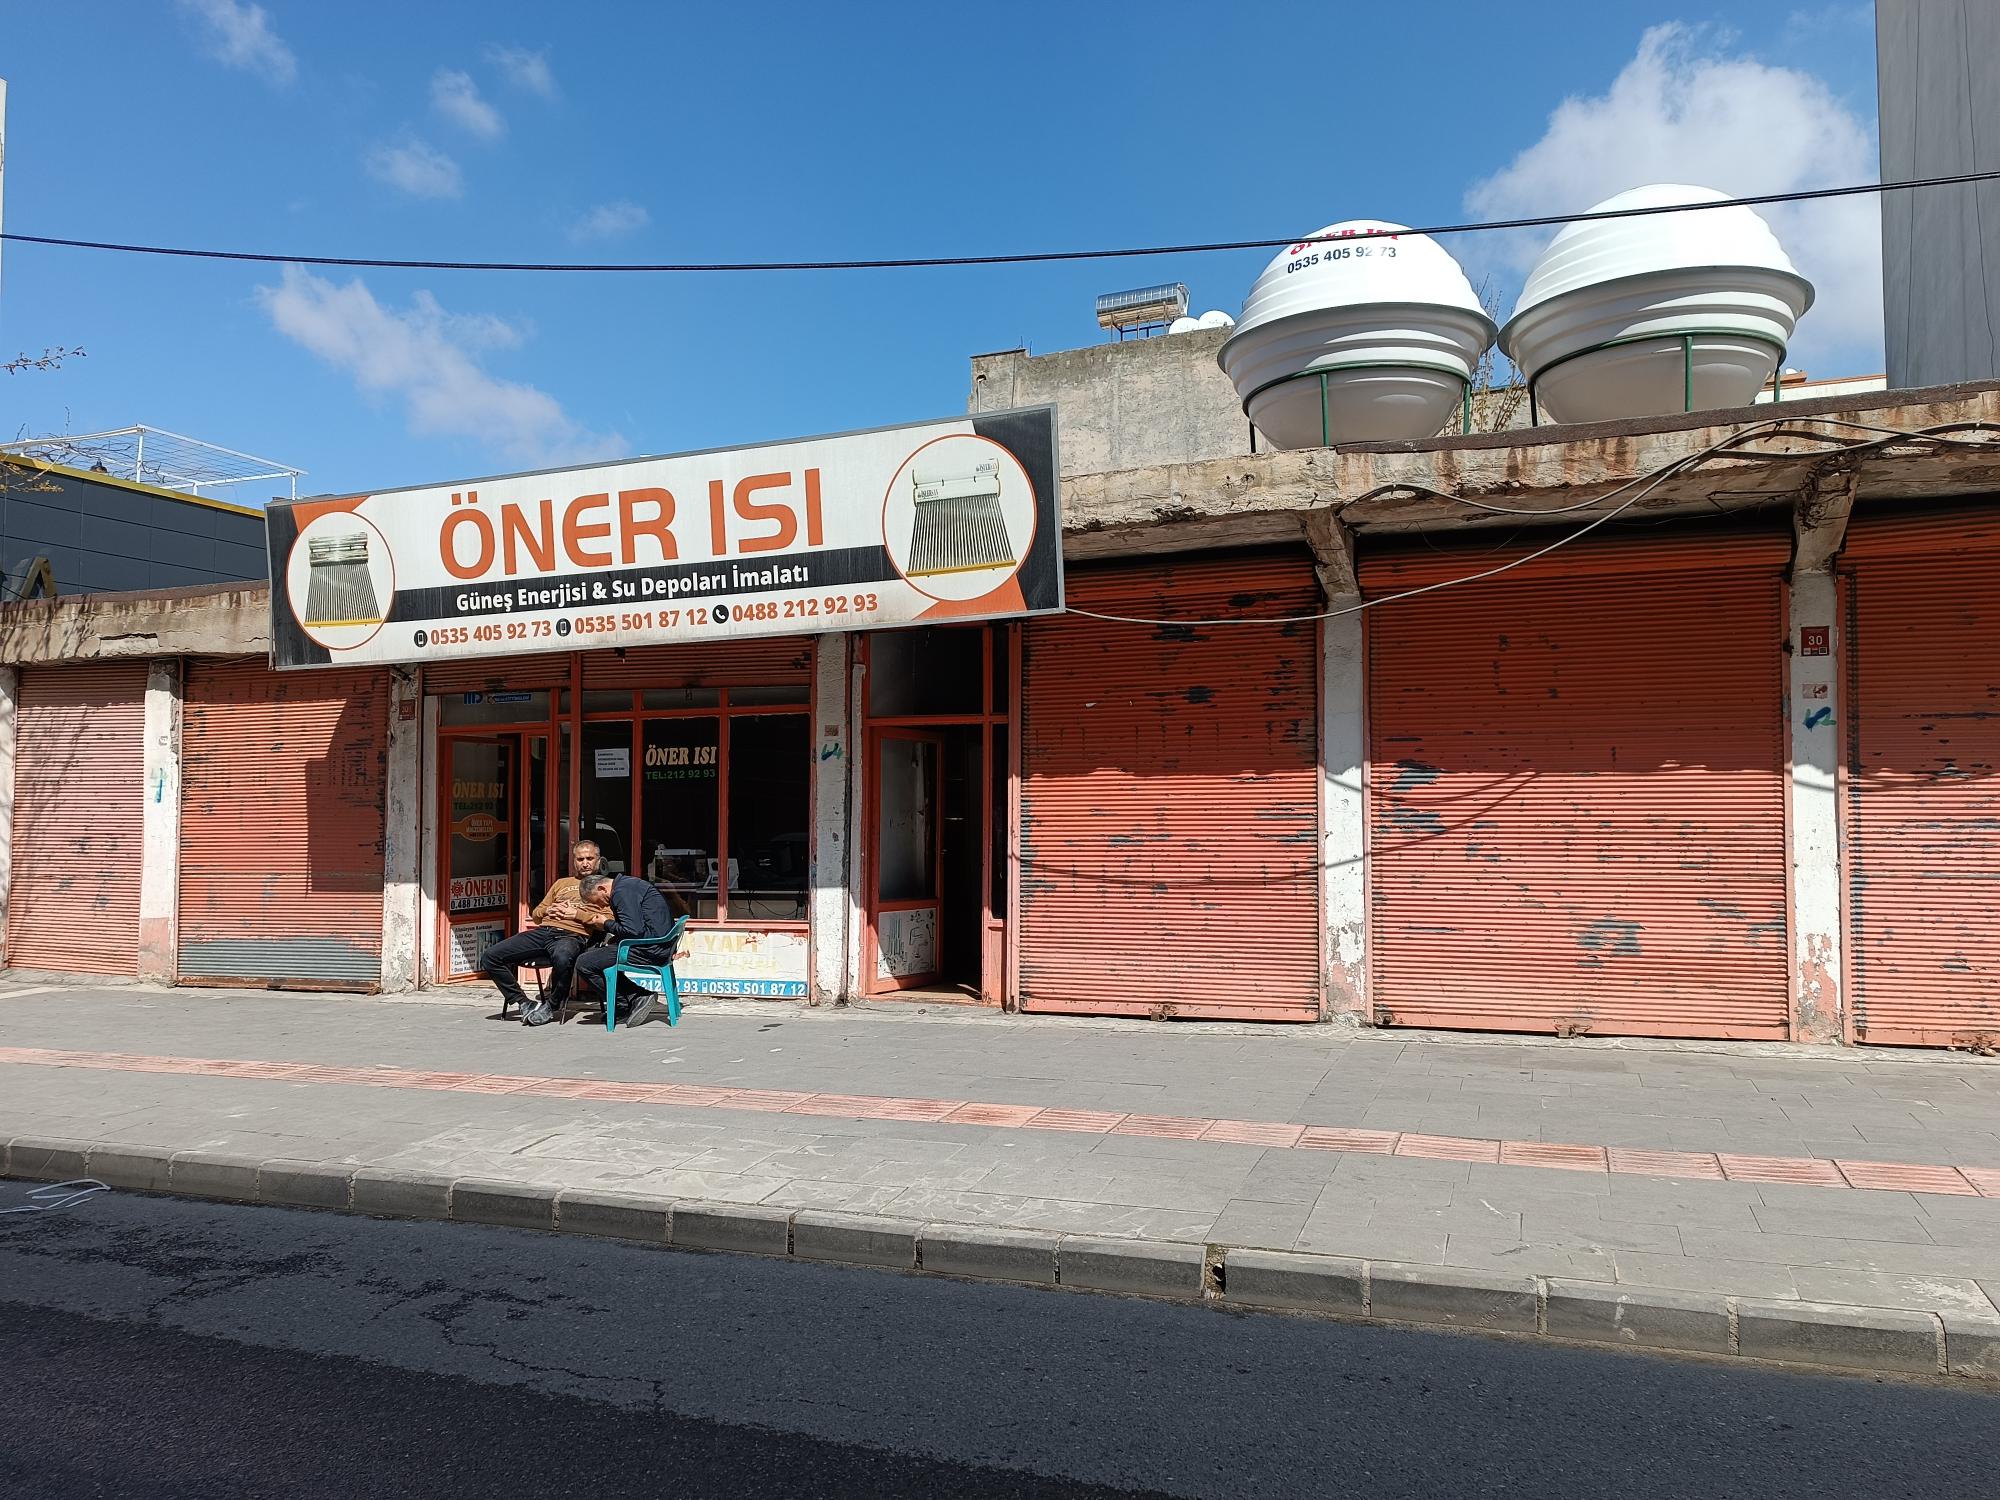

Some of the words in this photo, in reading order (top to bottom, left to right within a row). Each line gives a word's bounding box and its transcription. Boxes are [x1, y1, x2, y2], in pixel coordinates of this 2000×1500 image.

[1287, 254, 1319, 274] 0535
[1324, 247, 1351, 262] 405
[1356, 246, 1374, 258] 92
[1379, 246, 1397, 258] 73
[440, 487, 679, 580] ÖNER
[708, 467, 824, 556] ISI
[456, 588, 513, 613] Güneş
[518, 580, 587, 608] Enerjisi
[592, 583, 608, 599] &
[612, 579, 637, 598] Su
[641, 571, 727, 599] Depoları
[732, 564, 809, 588] İmalatı
[430, 627, 469, 646] 0535
[473, 624, 503, 642] 405
[507, 622, 528, 640] 92
[531, 619, 552, 638] 73
[574, 615, 618, 635] 0535
[621, 612, 653, 631] 501
[658, 610, 679, 629] 87
[686, 607, 708, 626] 12
[732, 602, 779, 622] 0488
[783, 598, 819, 619] 212
[824, 596, 848, 615] 92
[853, 593, 878, 612] 93
[1808, 635, 1823, 646] 30
[645, 744, 690, 767] ÖNER
[692, 746, 717, 765] ISI
[646, 770, 686, 780] TEL:212
[688, 769, 701, 779] 92
[703, 768, 716, 778] 93
[453, 778, 485, 799] ÖNER
[465, 878, 493, 897] ÖNER
[495, 879, 506, 894] ISI
[451, 899, 471, 909] 0.488
[474, 898, 485, 907] 212
[487, 896, 496, 905] 92
[498, 895, 506, 904] 93
[684, 981, 698, 993] 93
[709, 981, 739, 994] 0535
[743, 982, 765, 995] 501
[771, 983, 785, 996] 87
[790, 984, 805, 996] 12
